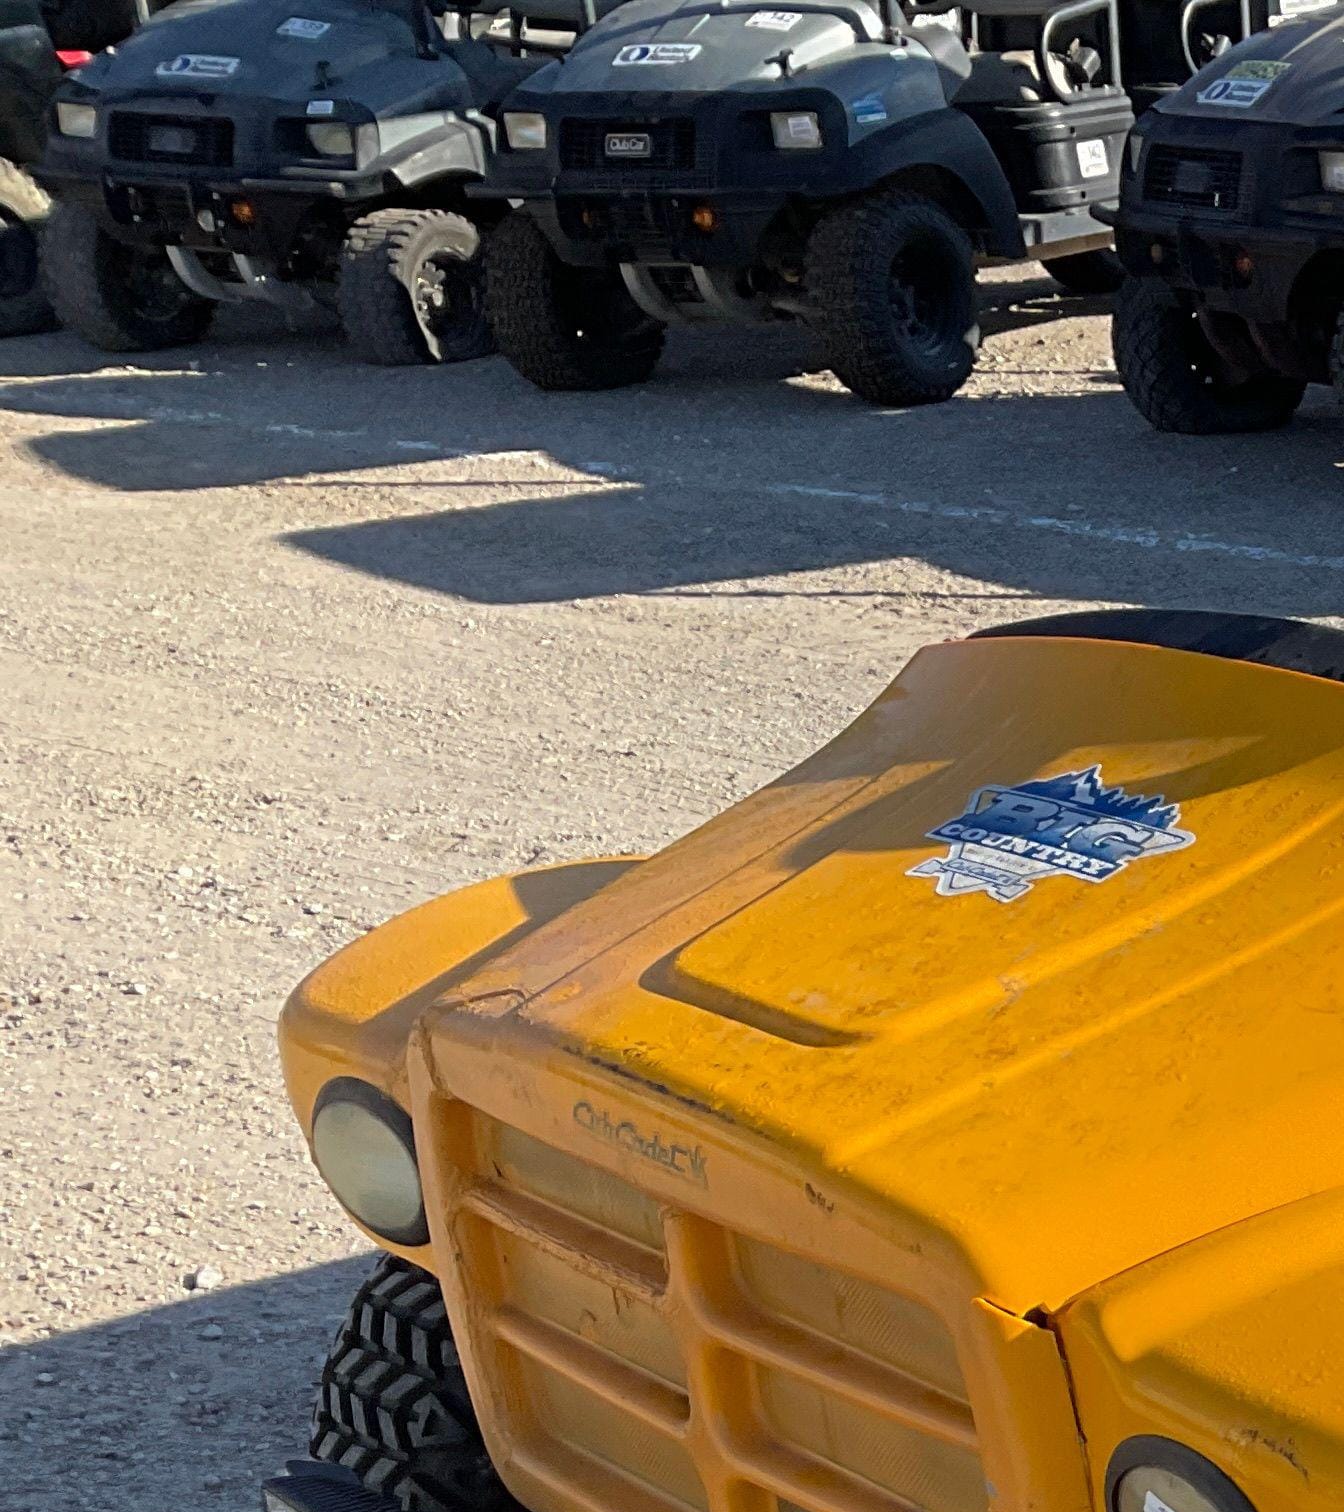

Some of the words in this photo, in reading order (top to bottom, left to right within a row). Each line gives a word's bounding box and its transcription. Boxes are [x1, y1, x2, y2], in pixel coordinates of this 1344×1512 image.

[610, 137, 629, 151] Club
[629, 138, 645, 151] Car
[939, 823, 1116, 877] COUNTRY
[990, 790, 1147, 863] BIG
